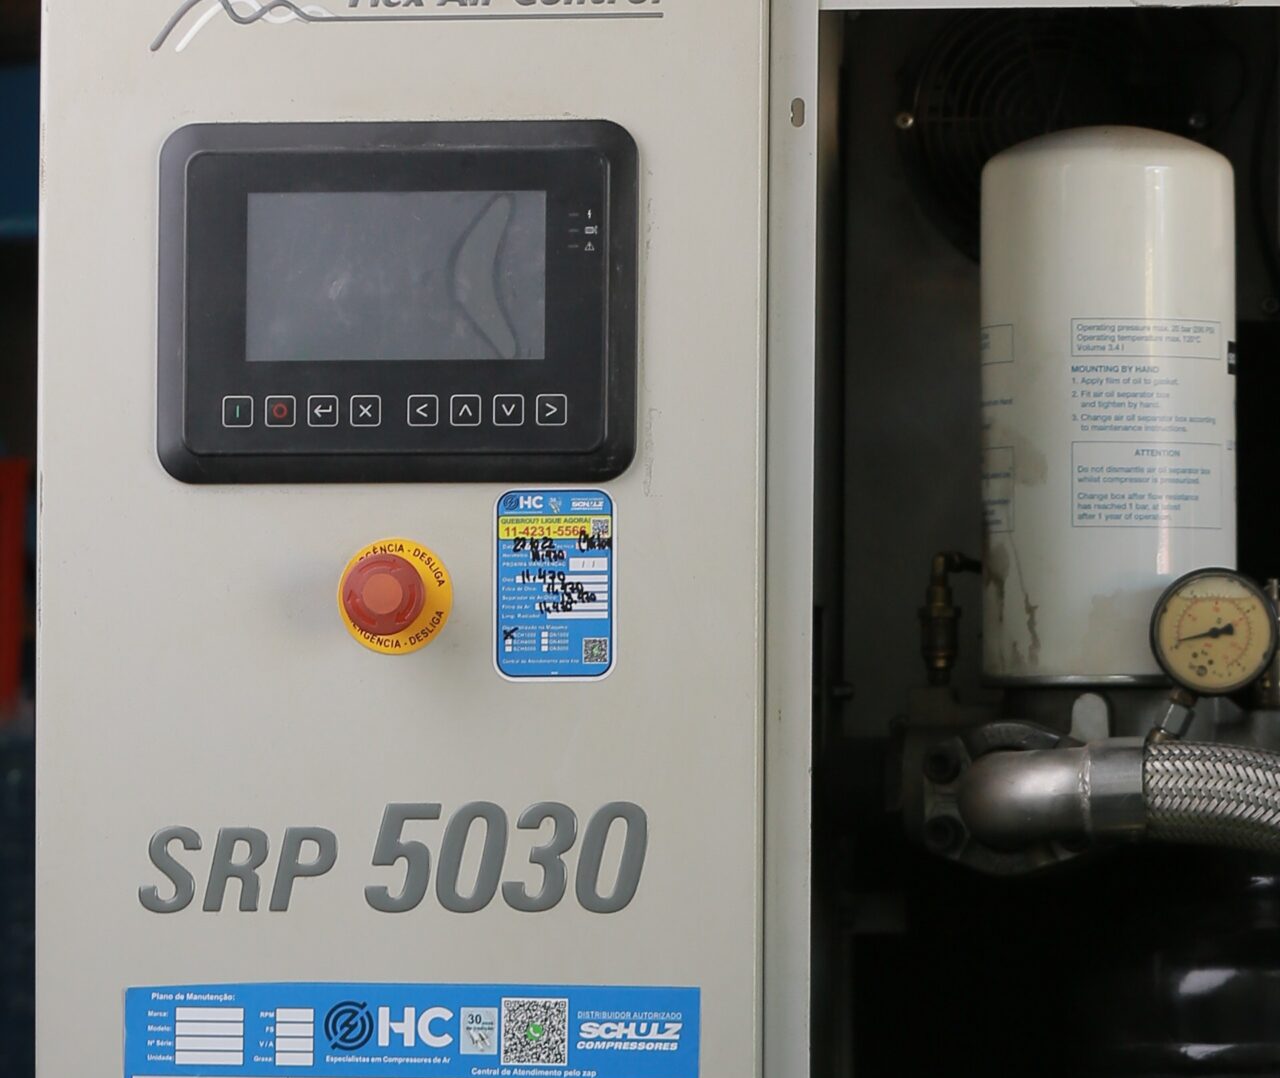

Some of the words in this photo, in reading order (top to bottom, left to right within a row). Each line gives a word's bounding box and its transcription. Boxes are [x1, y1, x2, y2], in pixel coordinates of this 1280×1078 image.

[1076, 323, 1116, 333] Operating
[1076, 333, 1116, 343] Operating
[1076, 343, 1106, 351] Volume
[1071, 365, 1120, 373] MOUNTING
[1121, 365, 1133, 373] BY
[1135, 365, 1160, 373] HAND
[1080, 377, 1104, 387] Apply
[1105, 377, 1121, 385] film
[1122, 377, 1131, 385] of
[1132, 377, 1142, 385] oil
[1116, 391, 1154, 400] separator
[1097, 401, 1126, 410] tighten
[1127, 401, 1138, 410] by
[1080, 414, 1112, 423] Change
[1114, 414, 1124, 422] air
[1126, 414, 1136, 422] oil
[1091, 424, 1143, 432] maintenance
[1134, 449, 1181, 457] ATTENTION
[1077, 465, 1089, 473] Do
[1105, 465, 1145, 473] dismantle
[1077, 476, 1101, 484] whilst
[1102, 476, 1150, 485] compressor
[520, 495, 544, 509] HC
[1077, 492, 1108, 502] Change
[1110, 492, 1125, 500] box
[1127, 492, 1145, 500] after
[1077, 503, 1092, 511] has
[1093, 503, 1127, 511] reached
[501, 517, 539, 525] QUEBROU?
[1077, 513, 1095, 521] after
[1105, 514, 1123, 523] year
[1124, 513, 1133, 521] of
[504, 525, 587, 537] 11-4231-5566
[413, 548, 446, 587] DESLIGA
[408, 610, 445, 646] DESLIGA
[138, 825, 339, 914] SRP
[364, 800, 649, 914] 5030
[151, 992, 174, 1001] Plano
[175, 992, 185, 1001] de
[186, 992, 236, 1003] Manutenção:
[467, 1013, 482, 1025] 30
[576, 1010, 631, 1020] DISTRIBUIDOR
[632, 1011, 682, 1020] AUTORIZADO
[147, 1024, 172, 1033] Modelo:
[377, 1006, 454, 1048] HC
[578, 1021, 684, 1040] SCHULZ
[576, 1041, 678, 1051] COMPRESSORES
[325, 1055, 370, 1065] Especialistas
[383, 1056, 432, 1065] Compressores
[433, 1056, 443, 1064] de
[443, 1056, 451, 1064] Ar
[471, 1067, 500, 1076] Central
[501, 1068, 512, 1076] de
[512, 1068, 563, 1078] Atendimento
[563, 1069, 581, 1078] pelo
